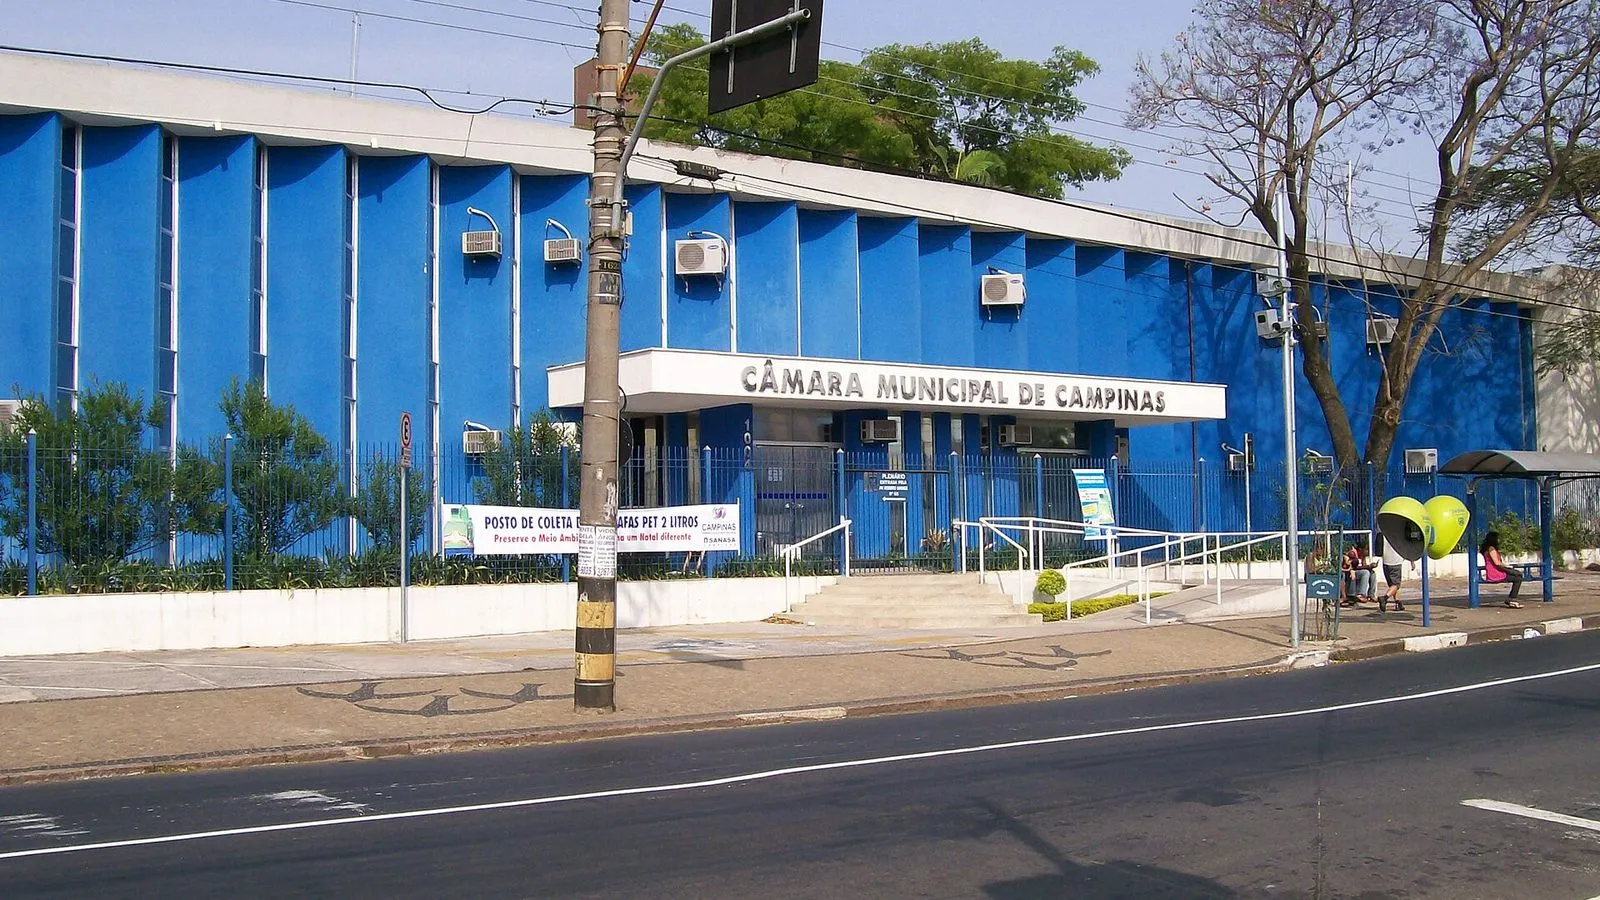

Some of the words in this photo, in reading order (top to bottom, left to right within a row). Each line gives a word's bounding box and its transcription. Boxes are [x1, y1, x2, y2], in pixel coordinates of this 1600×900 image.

[741, 359, 864, 397] CÂMARA
[876, 374, 1009, 404] MUNICIPAL
[1018, 382, 1046, 406] DE
[1055, 384, 1166, 412] CAMPINAS
[484, 516, 517, 529] POSTO
[522, 516, 534, 529] DE
[538, 516, 573, 529] COLETA
[616, 516, 639, 529] AFAS
[642, 516, 658, 528] PET
[662, 516, 667, 528] 2
[670, 515, 698, 528] LITROS
[702, 523, 736, 531] CAMPINAS
[494, 534, 529, 543] Preserve
[539, 534, 557, 542] Meio
[560, 534, 579, 542] Ambi
[640, 533, 658, 541] Natal
[660, 532, 691, 541] diferente
